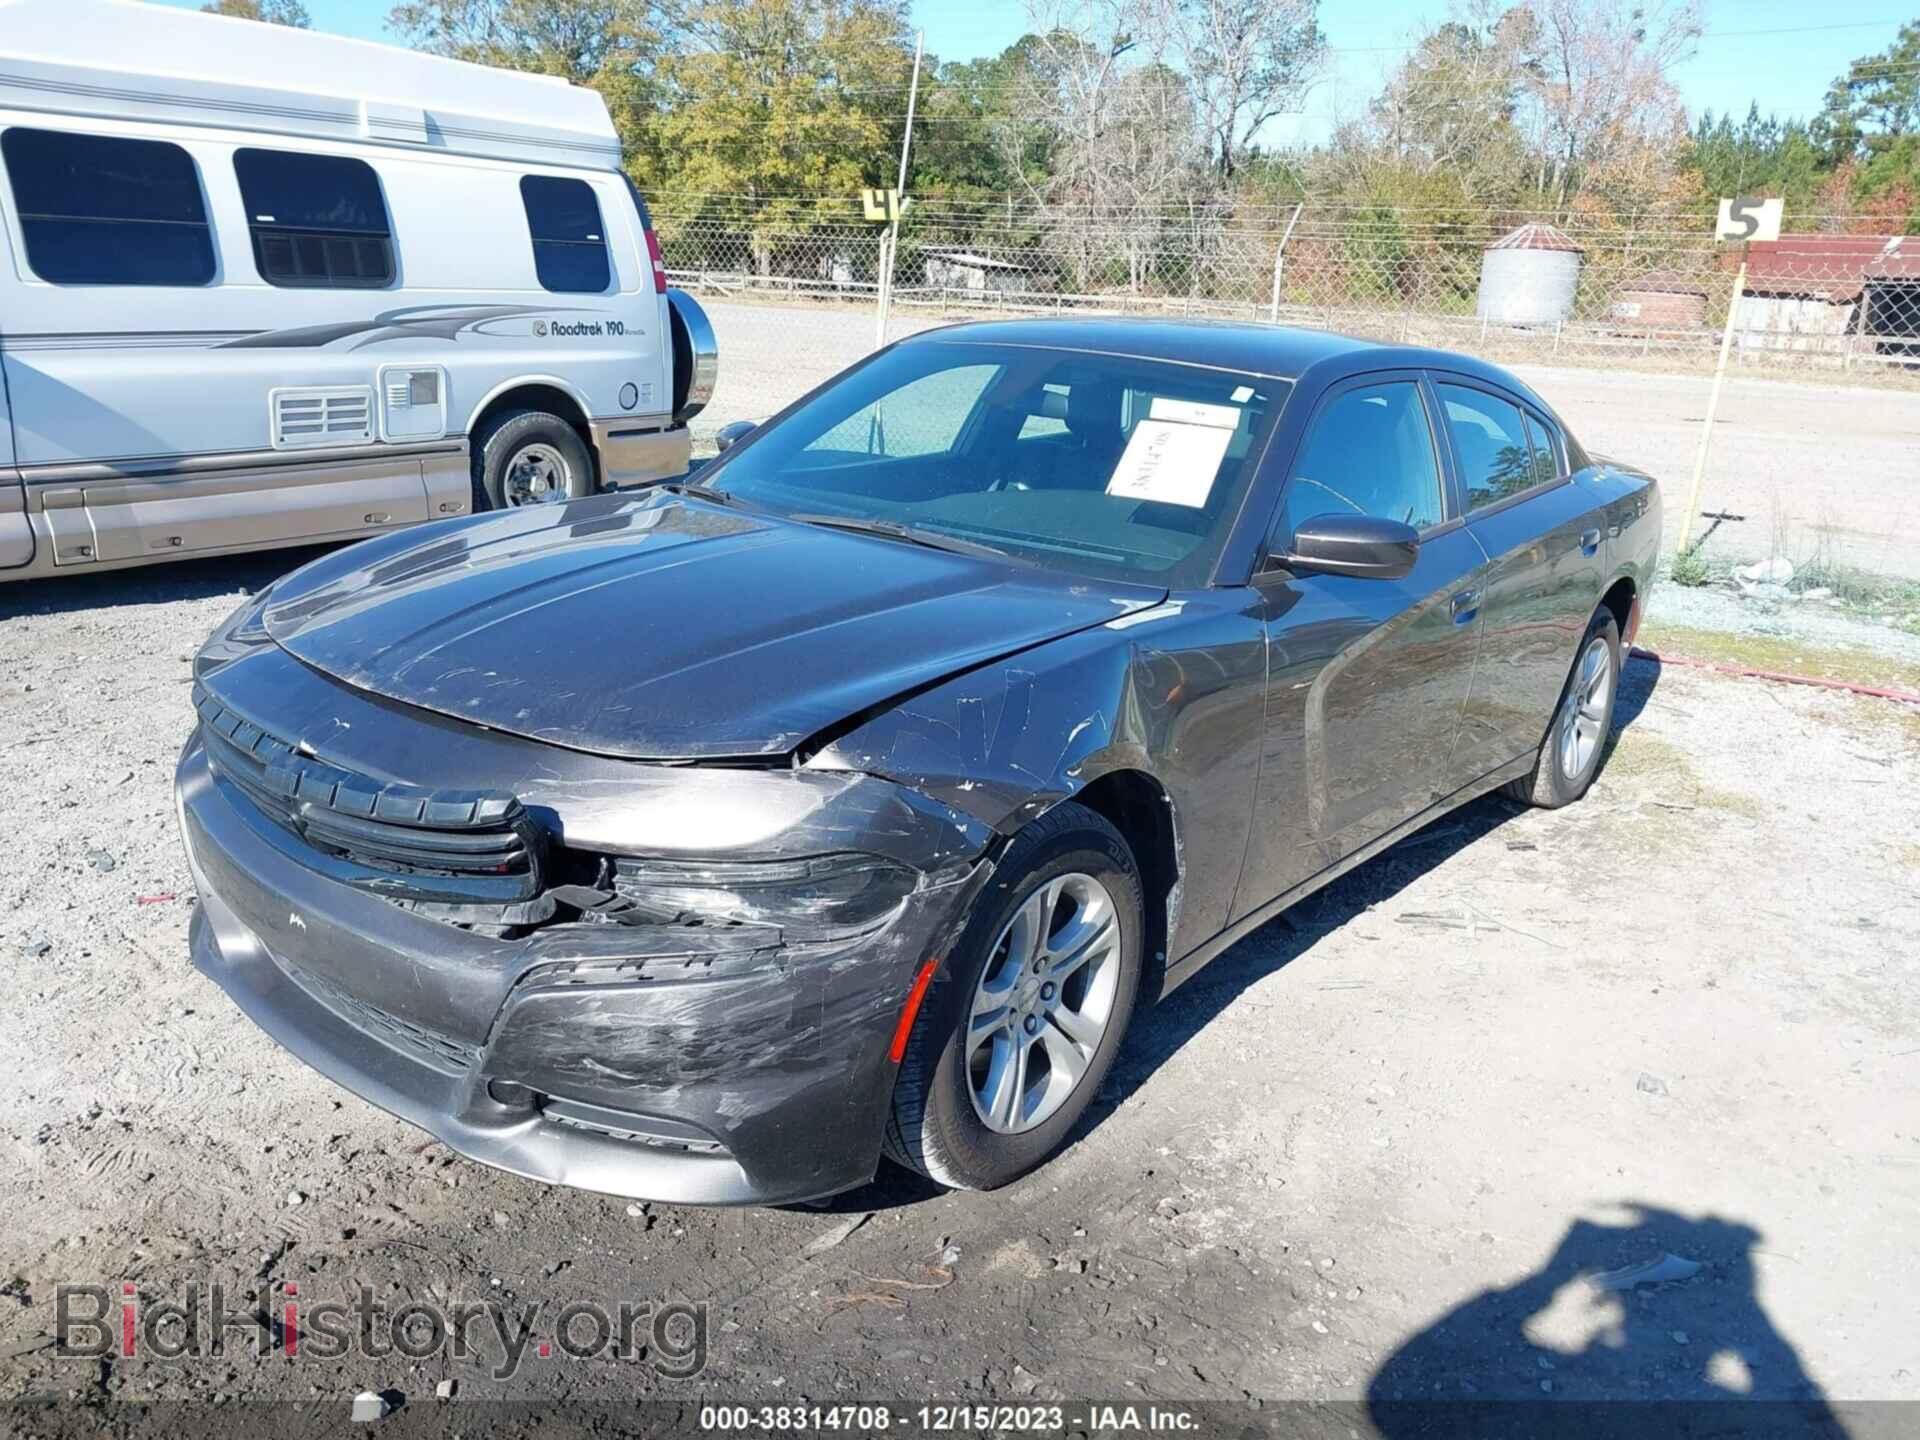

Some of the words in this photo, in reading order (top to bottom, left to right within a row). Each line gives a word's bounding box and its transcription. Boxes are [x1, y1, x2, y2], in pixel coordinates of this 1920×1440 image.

[871, 189, 891, 220] 4
[1723, 196, 1765, 240] 5
[551, 321, 602, 336] Roadtrek
[605, 321, 624, 336] 190
